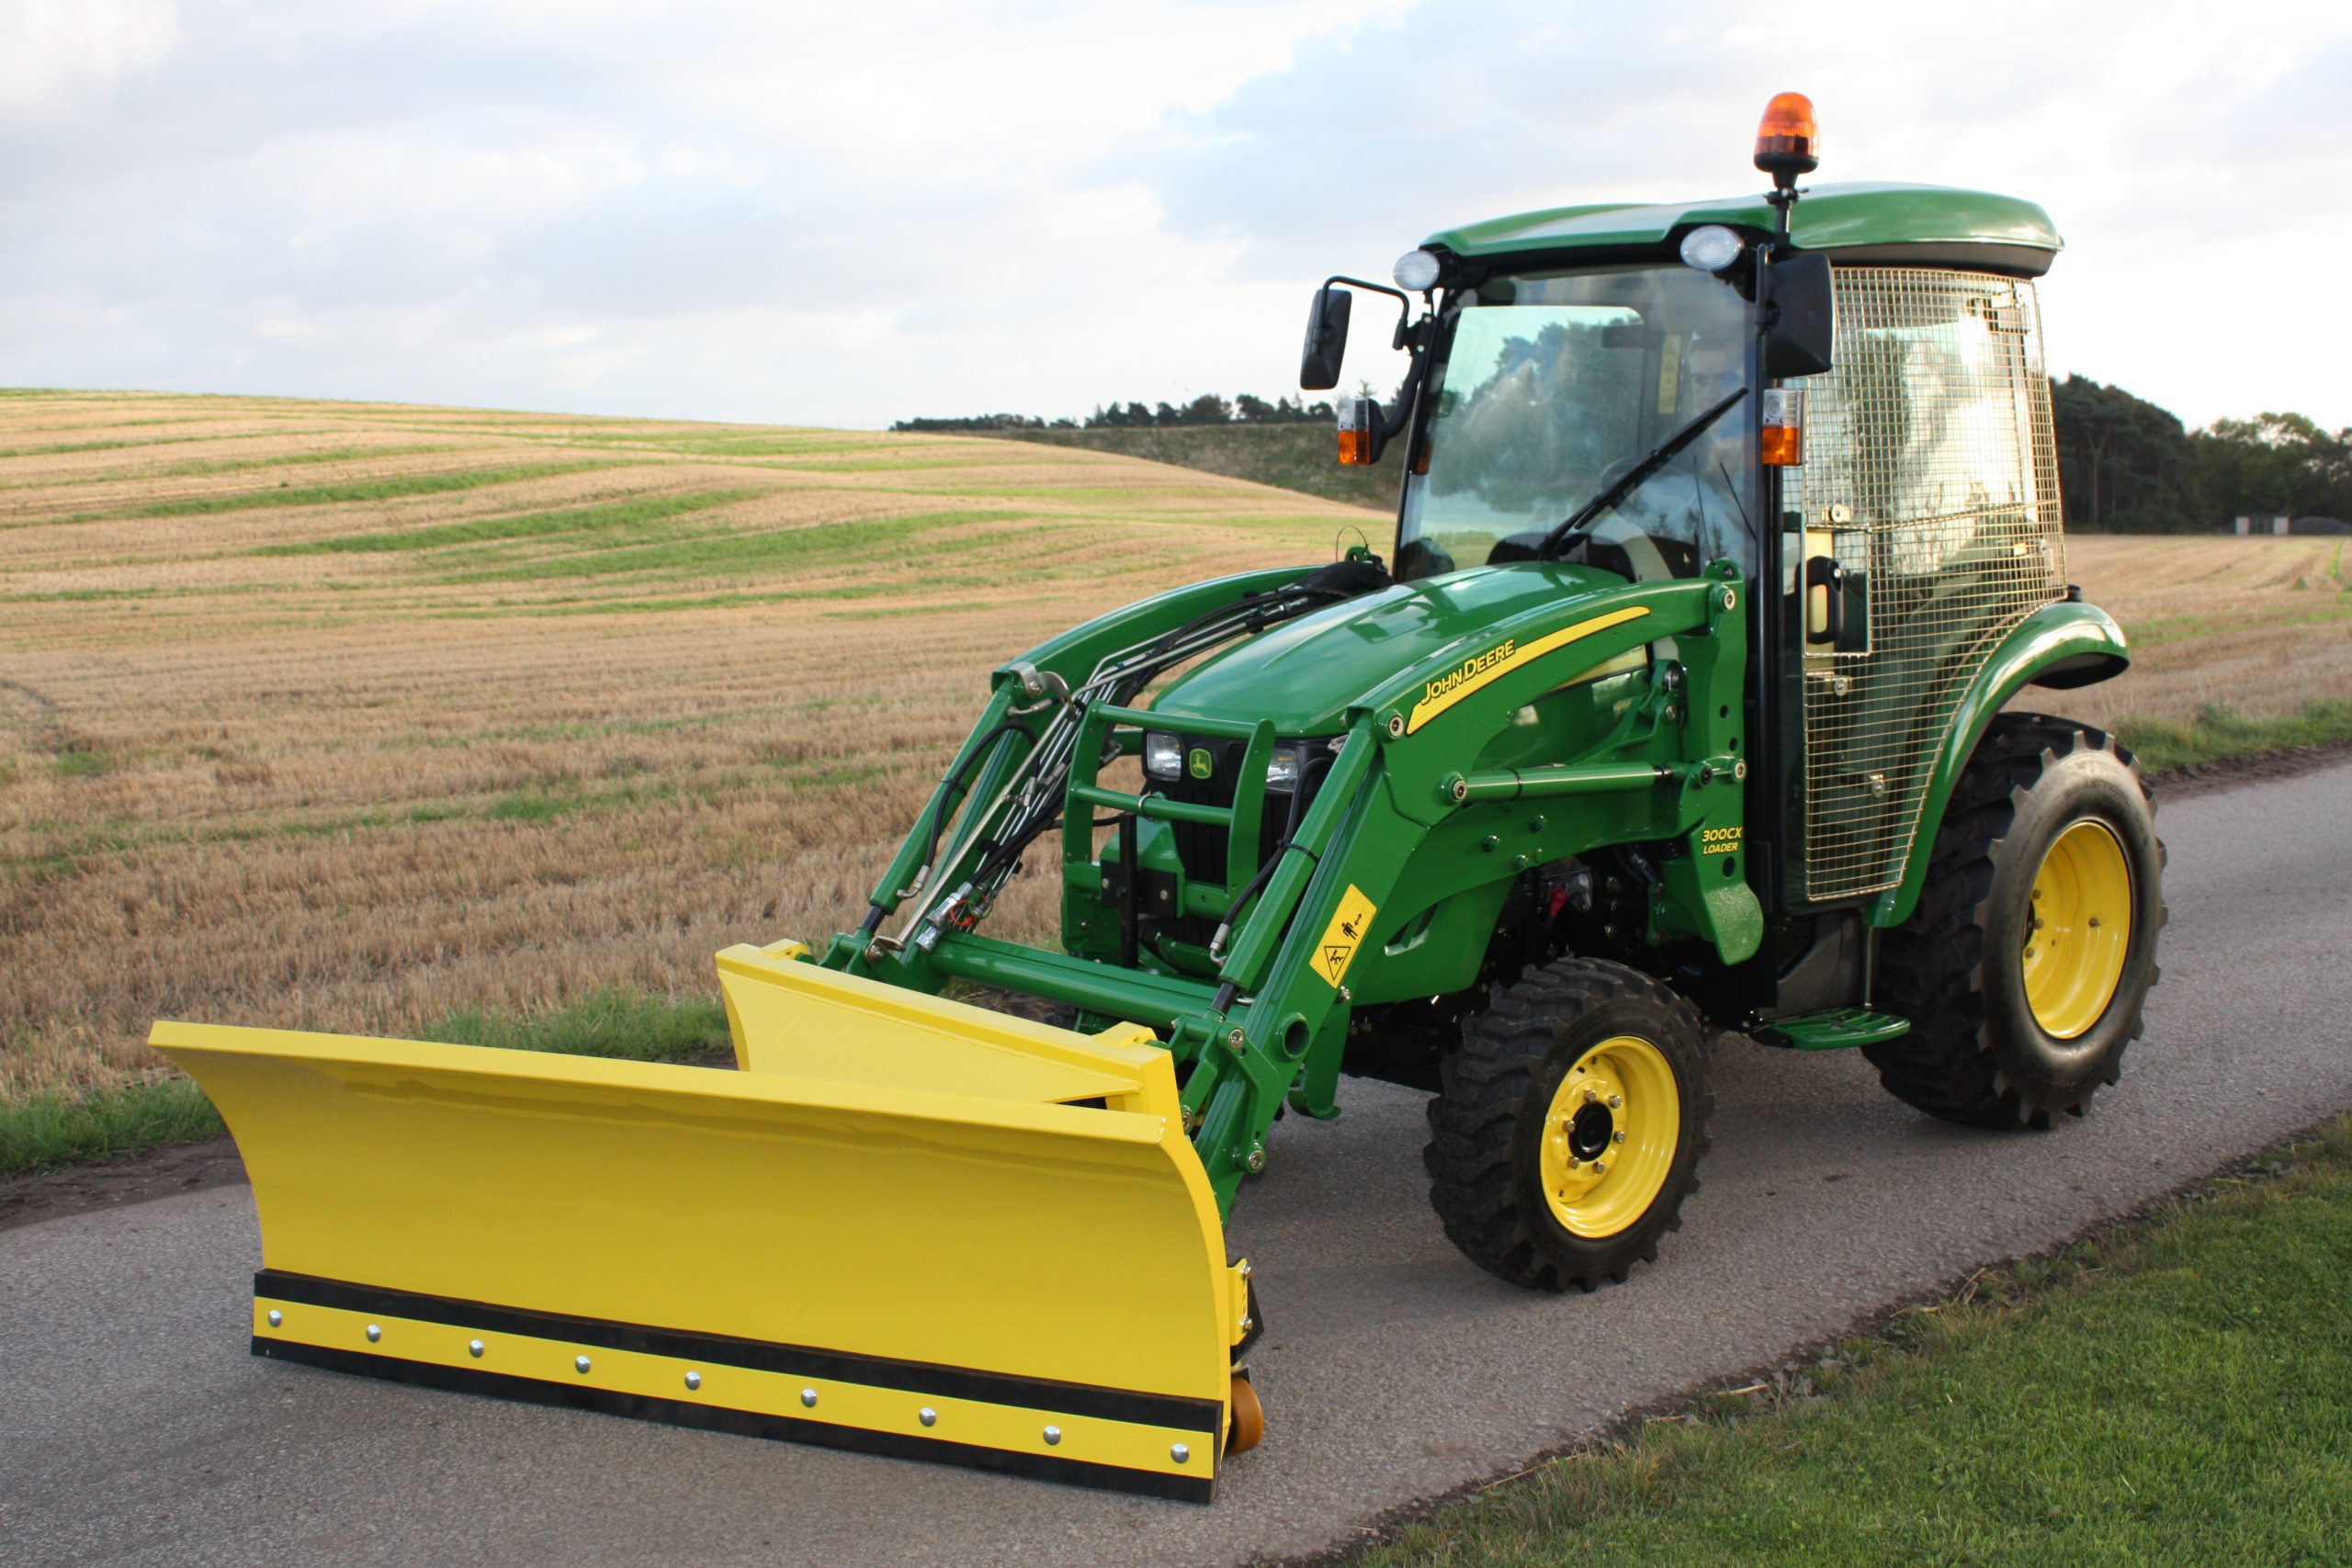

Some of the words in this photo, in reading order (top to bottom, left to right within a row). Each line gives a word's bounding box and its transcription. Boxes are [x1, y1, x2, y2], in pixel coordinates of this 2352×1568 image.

[1421, 668, 1464, 705] JOHN
[1464, 639, 1515, 682] DEERE
[1702, 827, 1743, 842] 300CX
[1702, 842, 1738, 854] LOADER
